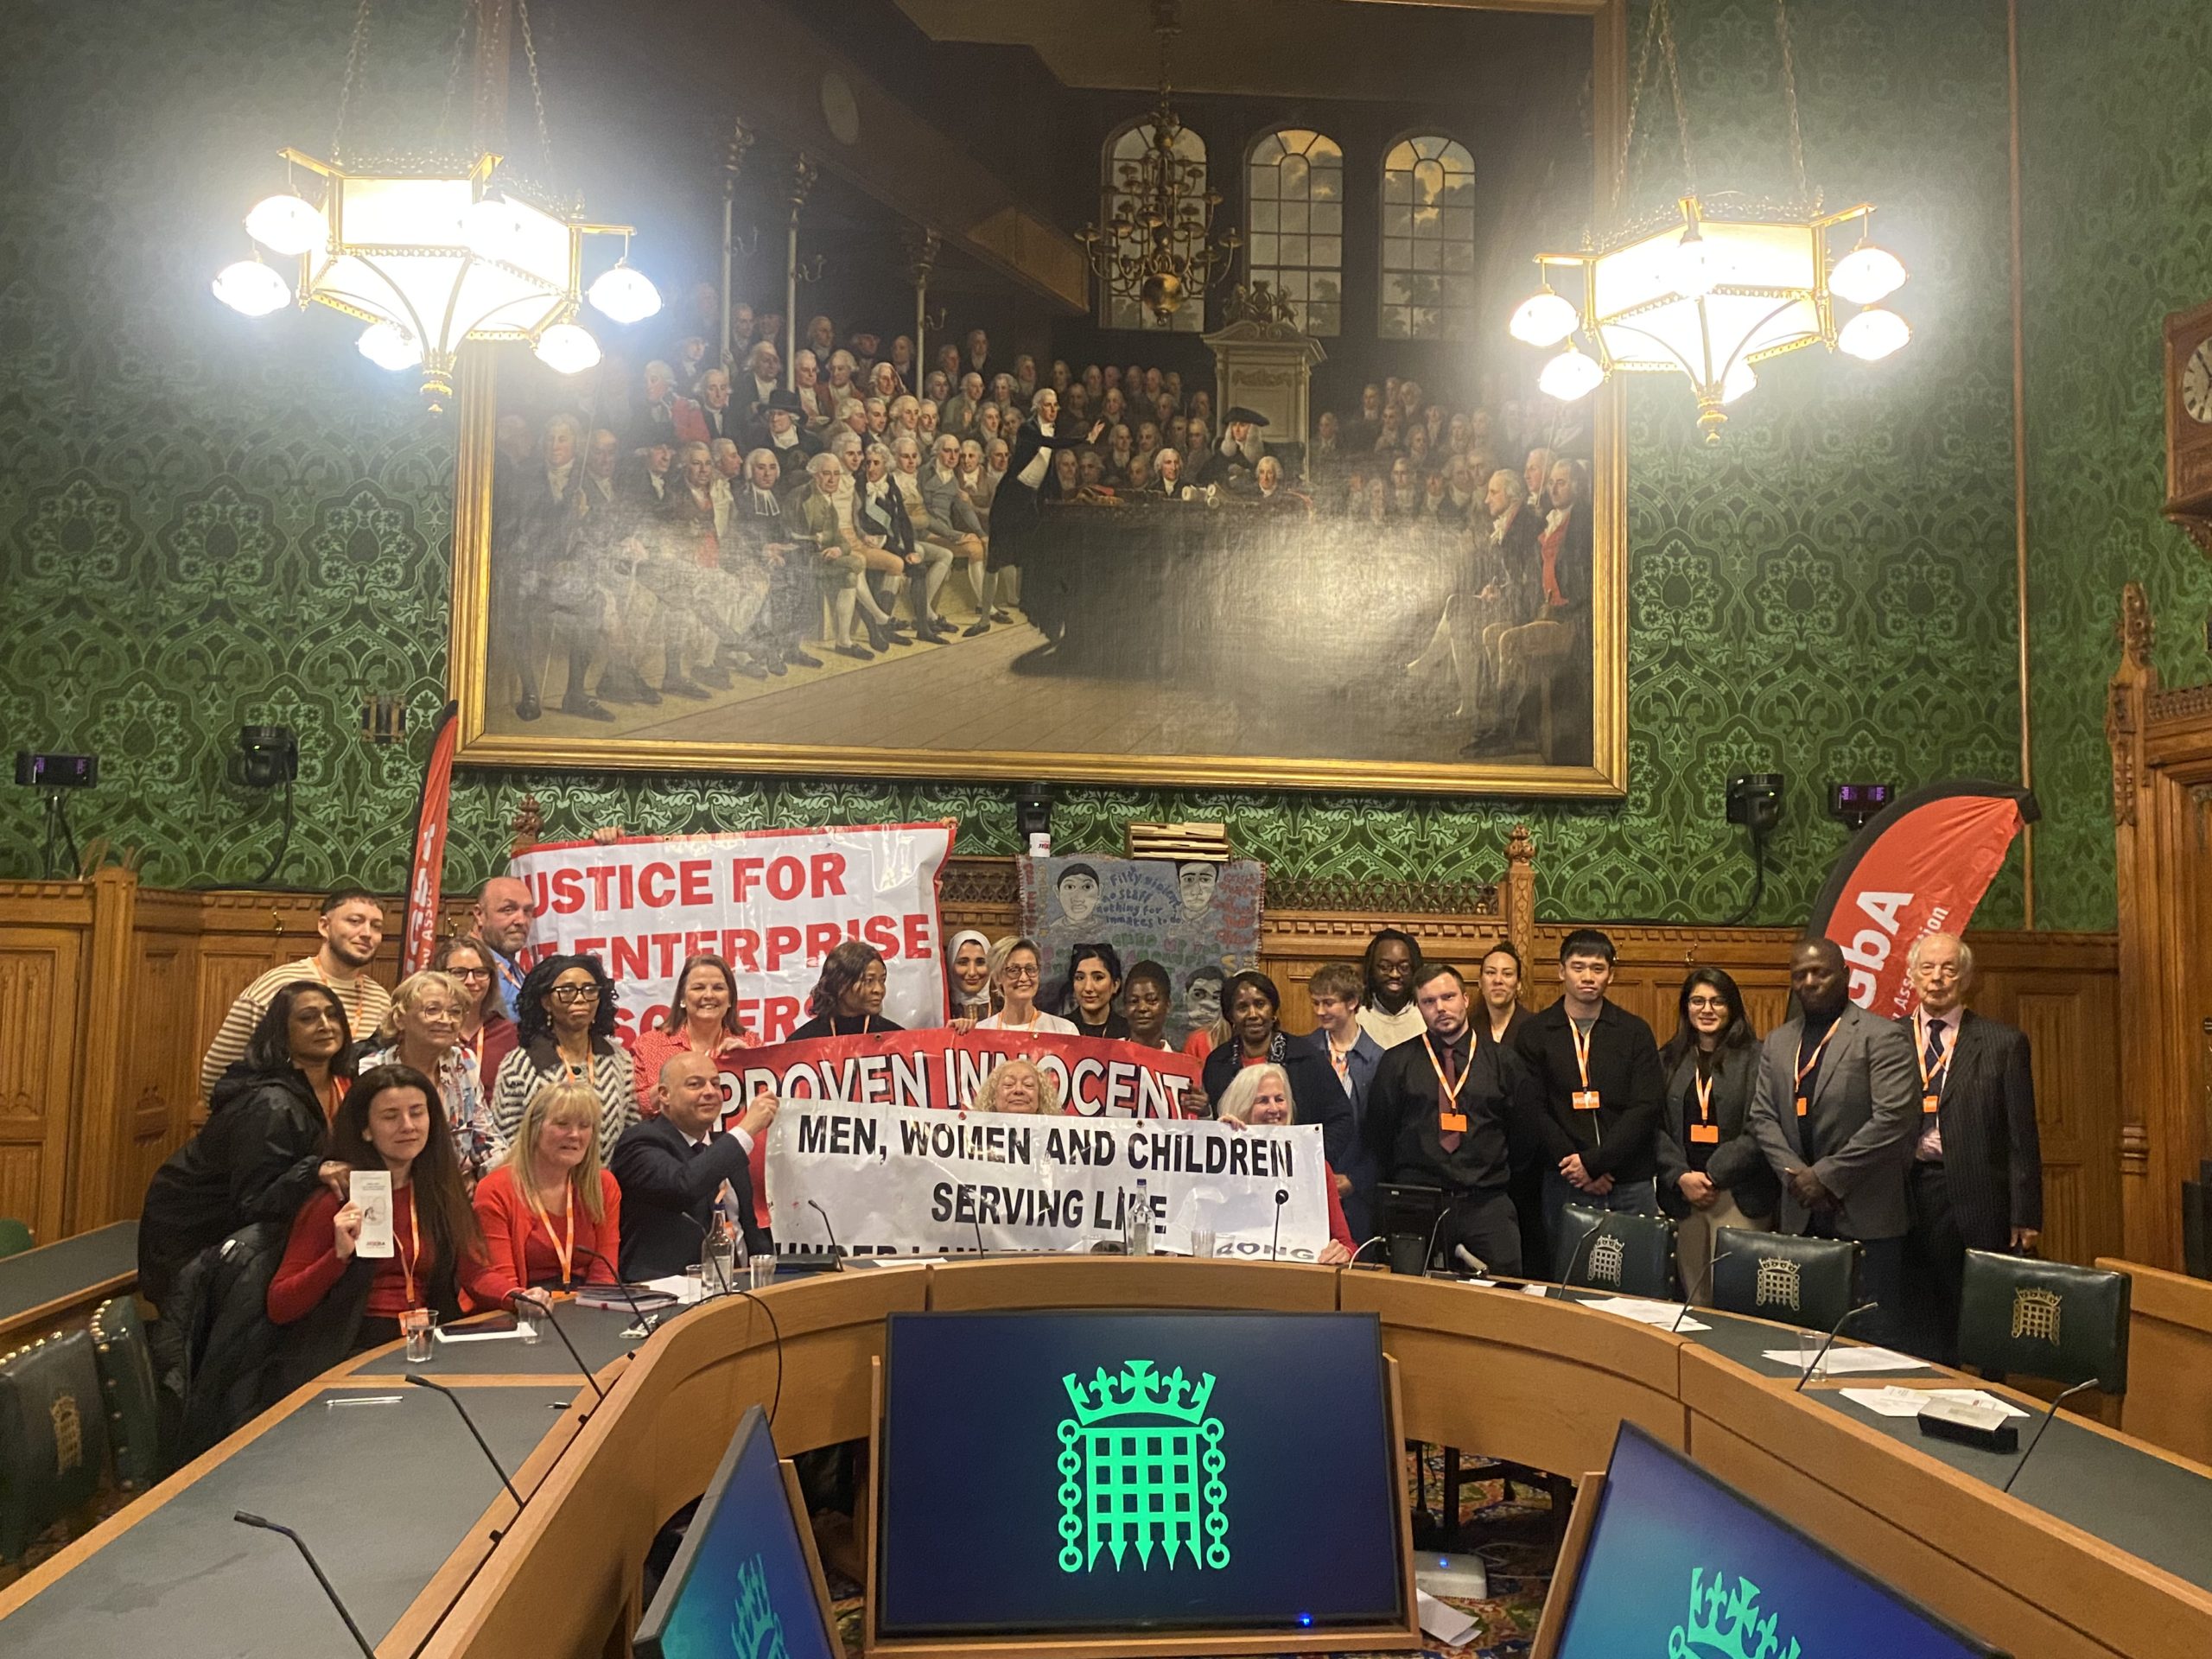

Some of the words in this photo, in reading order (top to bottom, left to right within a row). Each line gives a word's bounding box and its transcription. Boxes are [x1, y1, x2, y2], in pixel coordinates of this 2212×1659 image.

[524, 860, 714, 918] USTICE
[733, 852, 847, 903] FOR
[1096, 901, 1141, 917] nothing
[1143, 905, 1163, 916] for
[1157, 915, 1167, 925] to
[944, 1047, 1191, 1120] INOCENT
[798, 1115, 887, 1165] MEN,
[899, 1119, 1031, 1165] WOMEN
[1045, 1128, 1116, 1166] AND
[1128, 1132, 1294, 1178] CHILDREN
[931, 1181, 1084, 1229] SERVING
